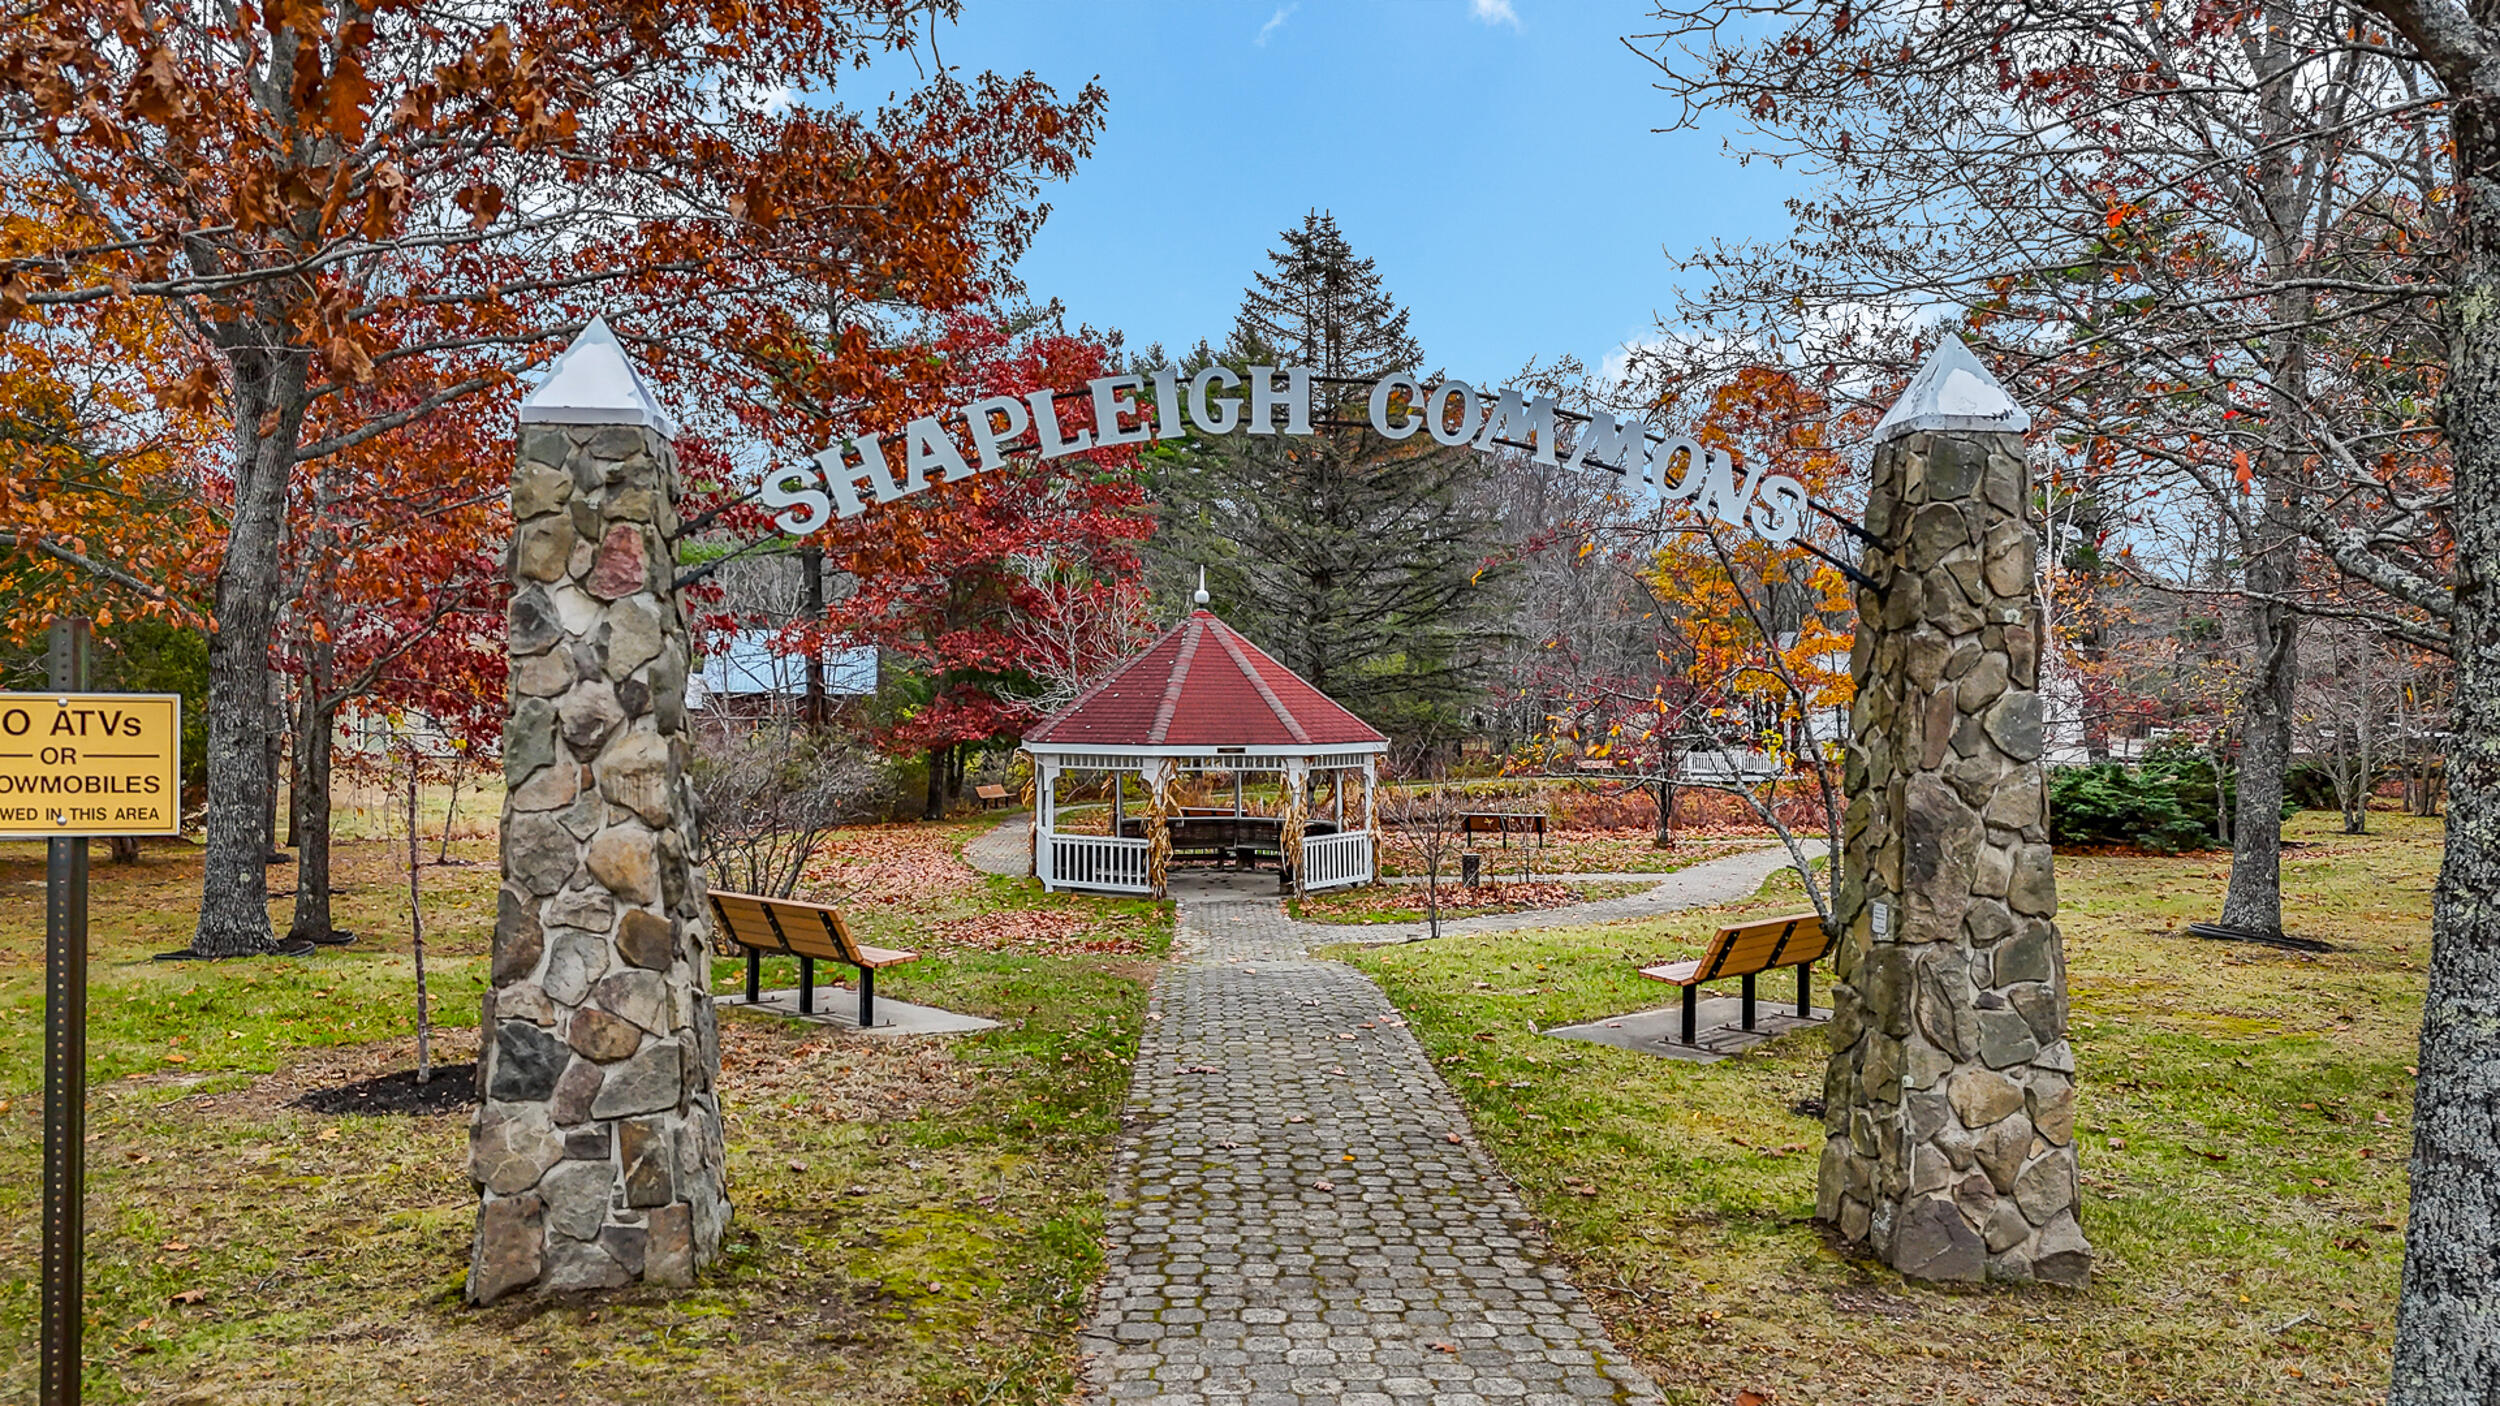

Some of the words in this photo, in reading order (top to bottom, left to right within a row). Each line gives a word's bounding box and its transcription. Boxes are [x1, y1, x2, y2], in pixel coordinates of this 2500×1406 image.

[760, 365, 1314, 536] SHAPLEIGH
[1368, 372, 1808, 543] COMMONS
[2, 708, 31, 737] O
[49, 709, 142, 737] ATVs
[40, 746, 77, 766] OR
[0, 774, 161, 794] OWMOBILES
[0, 806, 39, 821] WED
[45, 807, 63, 822] IN
[69, 807, 107, 821] THIS
[114, 807, 160, 821] AREA
